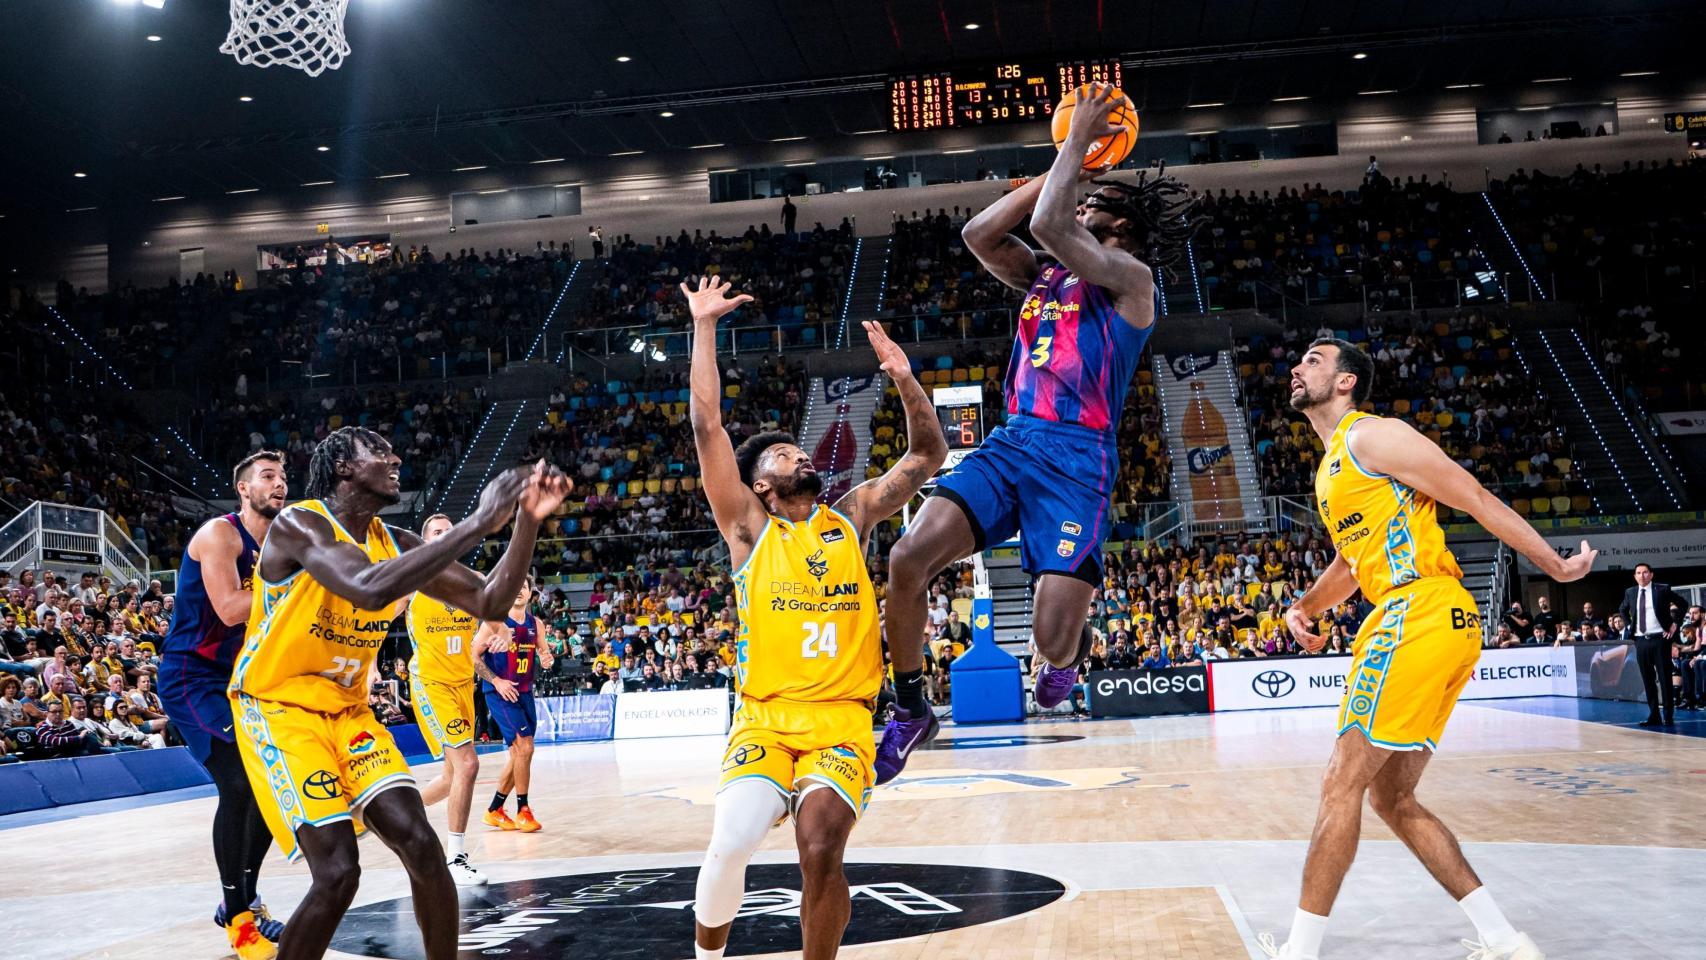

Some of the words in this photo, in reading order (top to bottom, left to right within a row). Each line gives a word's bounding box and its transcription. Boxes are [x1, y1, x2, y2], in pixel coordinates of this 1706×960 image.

[997, 64, 1021, 78] 1:26
[969, 90, 981, 103] 13
[1004, 89, 1008, 98] 1
[1035, 85, 1048, 97] 11
[965, 110, 973, 119] 4
[976, 110, 982, 118] 0
[1018, 105, 1025, 116] 3
[1028, 105, 1034, 114] 0
[1044, 103, 1051, 114] 5
[1031, 336, 1053, 368] 3
[961, 407, 976, 420] 26
[961, 421, 974, 444] 6
[1187, 444, 1231, 474] Clipper
[1624, 546, 1661, 555] llevamos
[771, 581, 859, 597] DREAMLAND
[788, 599, 860, 612] GranCanaria
[446, 635, 462, 655] 10
[801, 621, 838, 658] 24
[516, 658, 528, 673] 20
[1480, 664, 1552, 680] ELECTRIC
[1097, 672, 1205, 696] endesa
[349, 747, 390, 771] Poema
[355, 765, 369, 780] del
[834, 764, 855, 782] Mar
